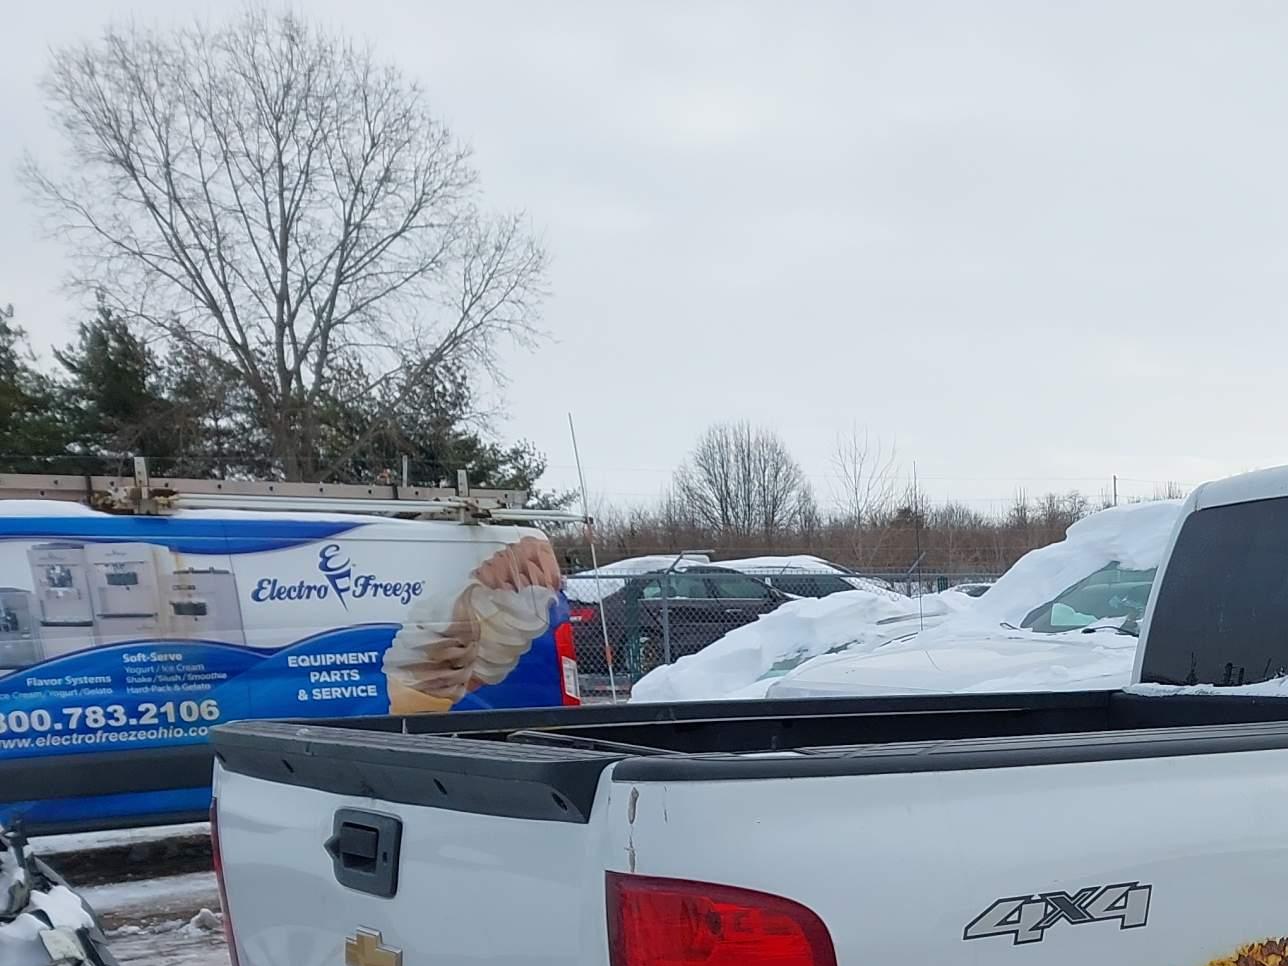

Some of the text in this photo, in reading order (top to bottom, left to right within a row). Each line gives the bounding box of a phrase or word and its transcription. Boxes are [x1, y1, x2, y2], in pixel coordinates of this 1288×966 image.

[251, 575, 424, 605] Electro Freeze
[122, 652, 183, 663] Soft-Serve
[288, 652, 378, 667] EQUIPMENT
[124, 664, 154, 675] Yogurt
[176, 663, 205, 671] Cream
[26, 675, 112, 687] Flavor Systems
[310, 670, 360, 683] PARTS
[182, 682, 211, 691] Gelato
[298, 685, 377, 701] & SERVICE
[0, 726, 208, 749] ww.electrofreezeohio.co
